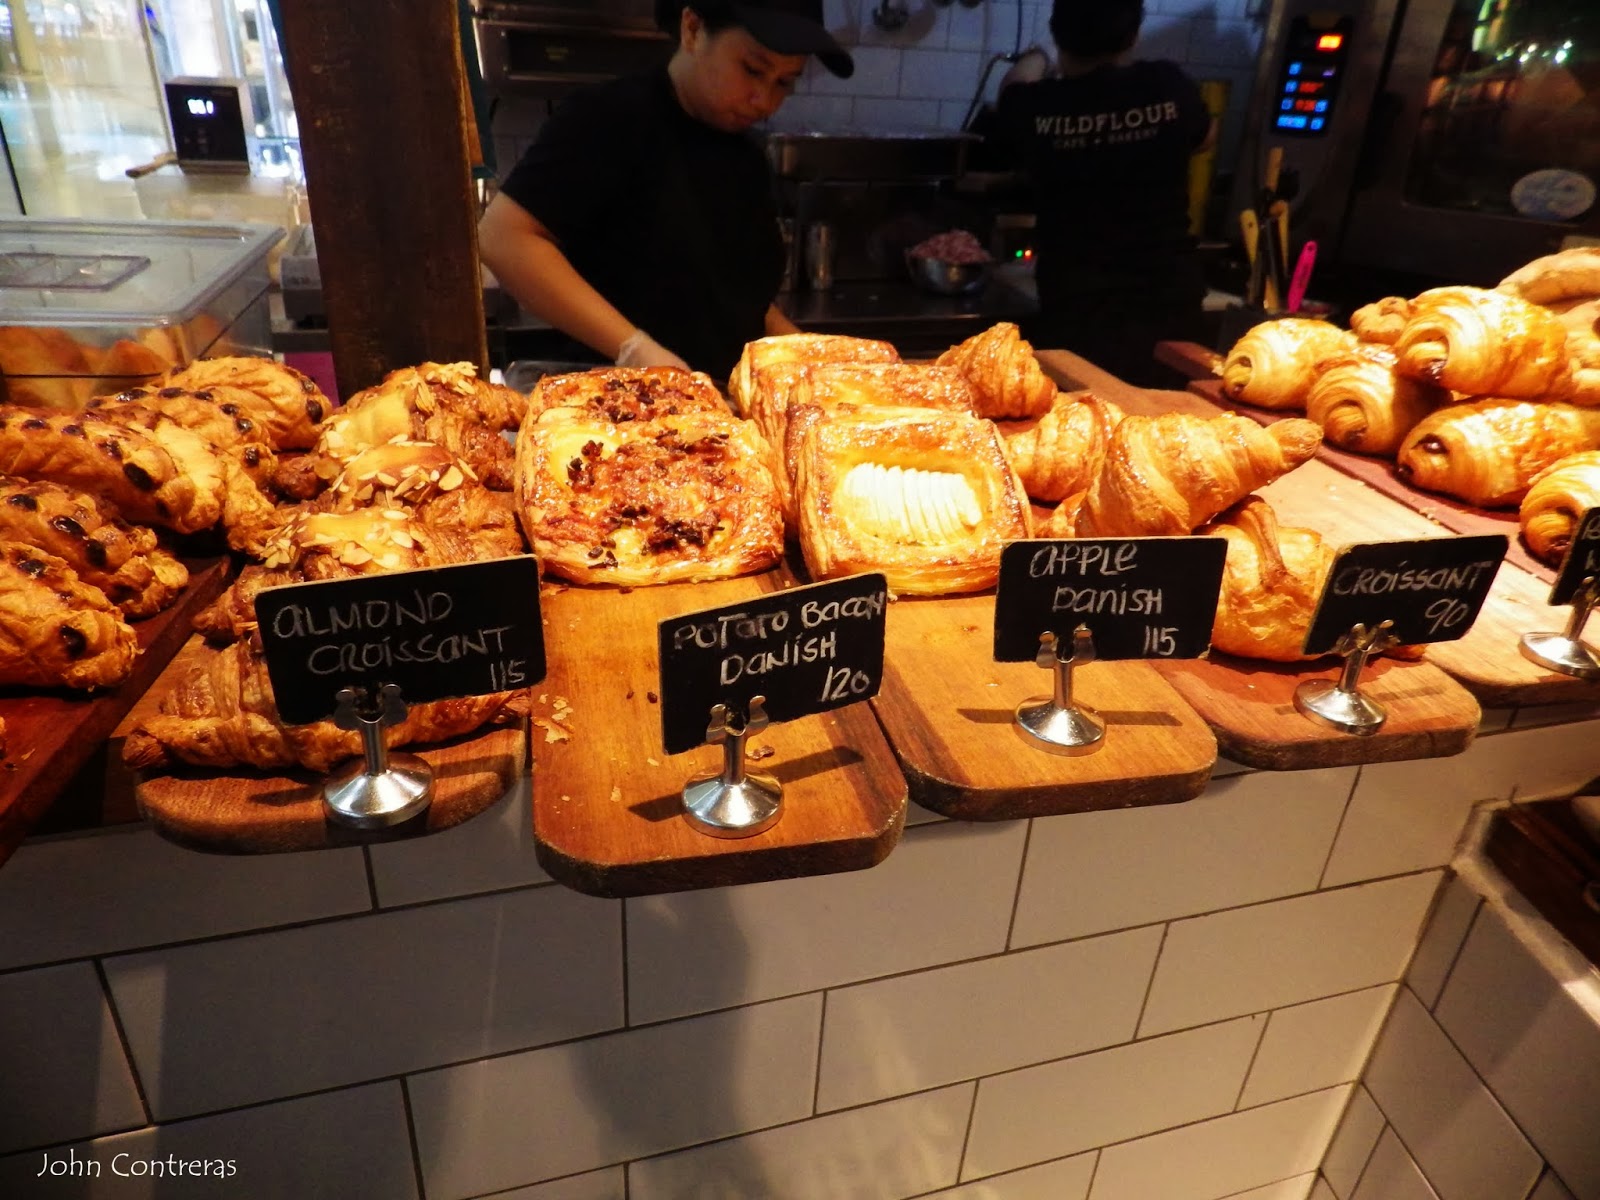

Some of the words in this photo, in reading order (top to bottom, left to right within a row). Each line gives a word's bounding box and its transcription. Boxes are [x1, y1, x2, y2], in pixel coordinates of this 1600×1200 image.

[1035, 100, 1178, 136] WILDFLOUR
[1425, 598, 1469, 636] 90
[1142, 625, 1179, 655] 115
[490, 661, 526, 691] 115
[821, 666, 870, 702] 120
